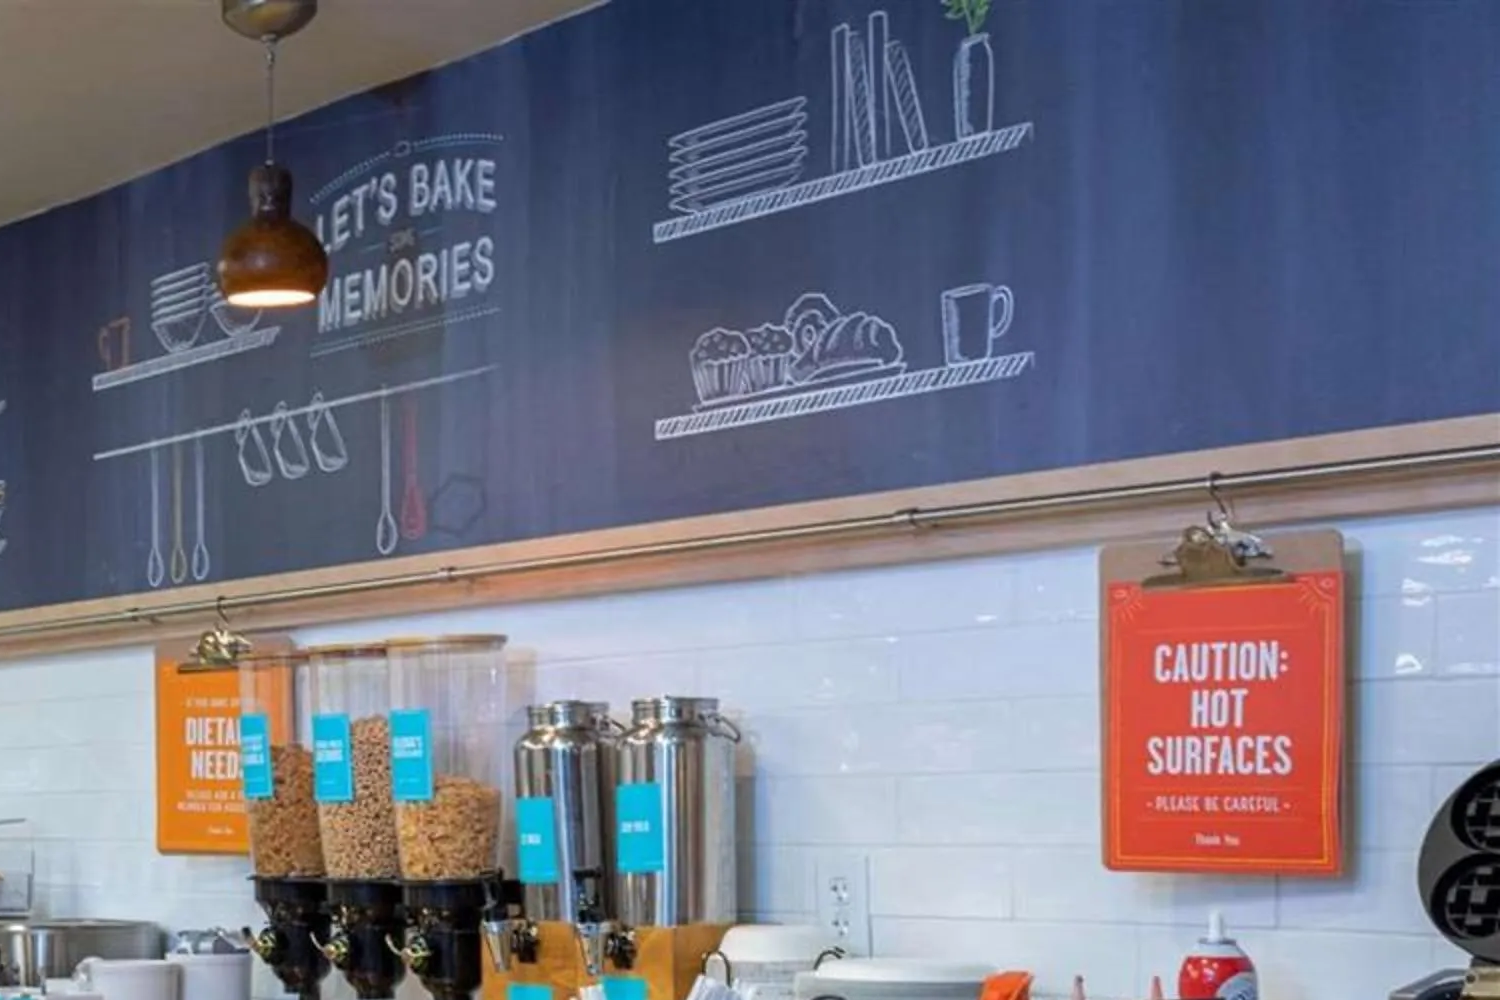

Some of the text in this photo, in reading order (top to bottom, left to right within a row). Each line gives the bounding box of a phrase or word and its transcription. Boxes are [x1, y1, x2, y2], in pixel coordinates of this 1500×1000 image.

[316, 157, 497, 255] LET'S BAKE
[318, 235, 496, 334] MEMORIES
[1154, 641, 1289, 682] CAUTION:
[1190, 688, 1249, 729] HOT
[1147, 735, 1293, 776] SURFACES
[1156, 796, 1280, 812] PLEASE BE CAREFUL
